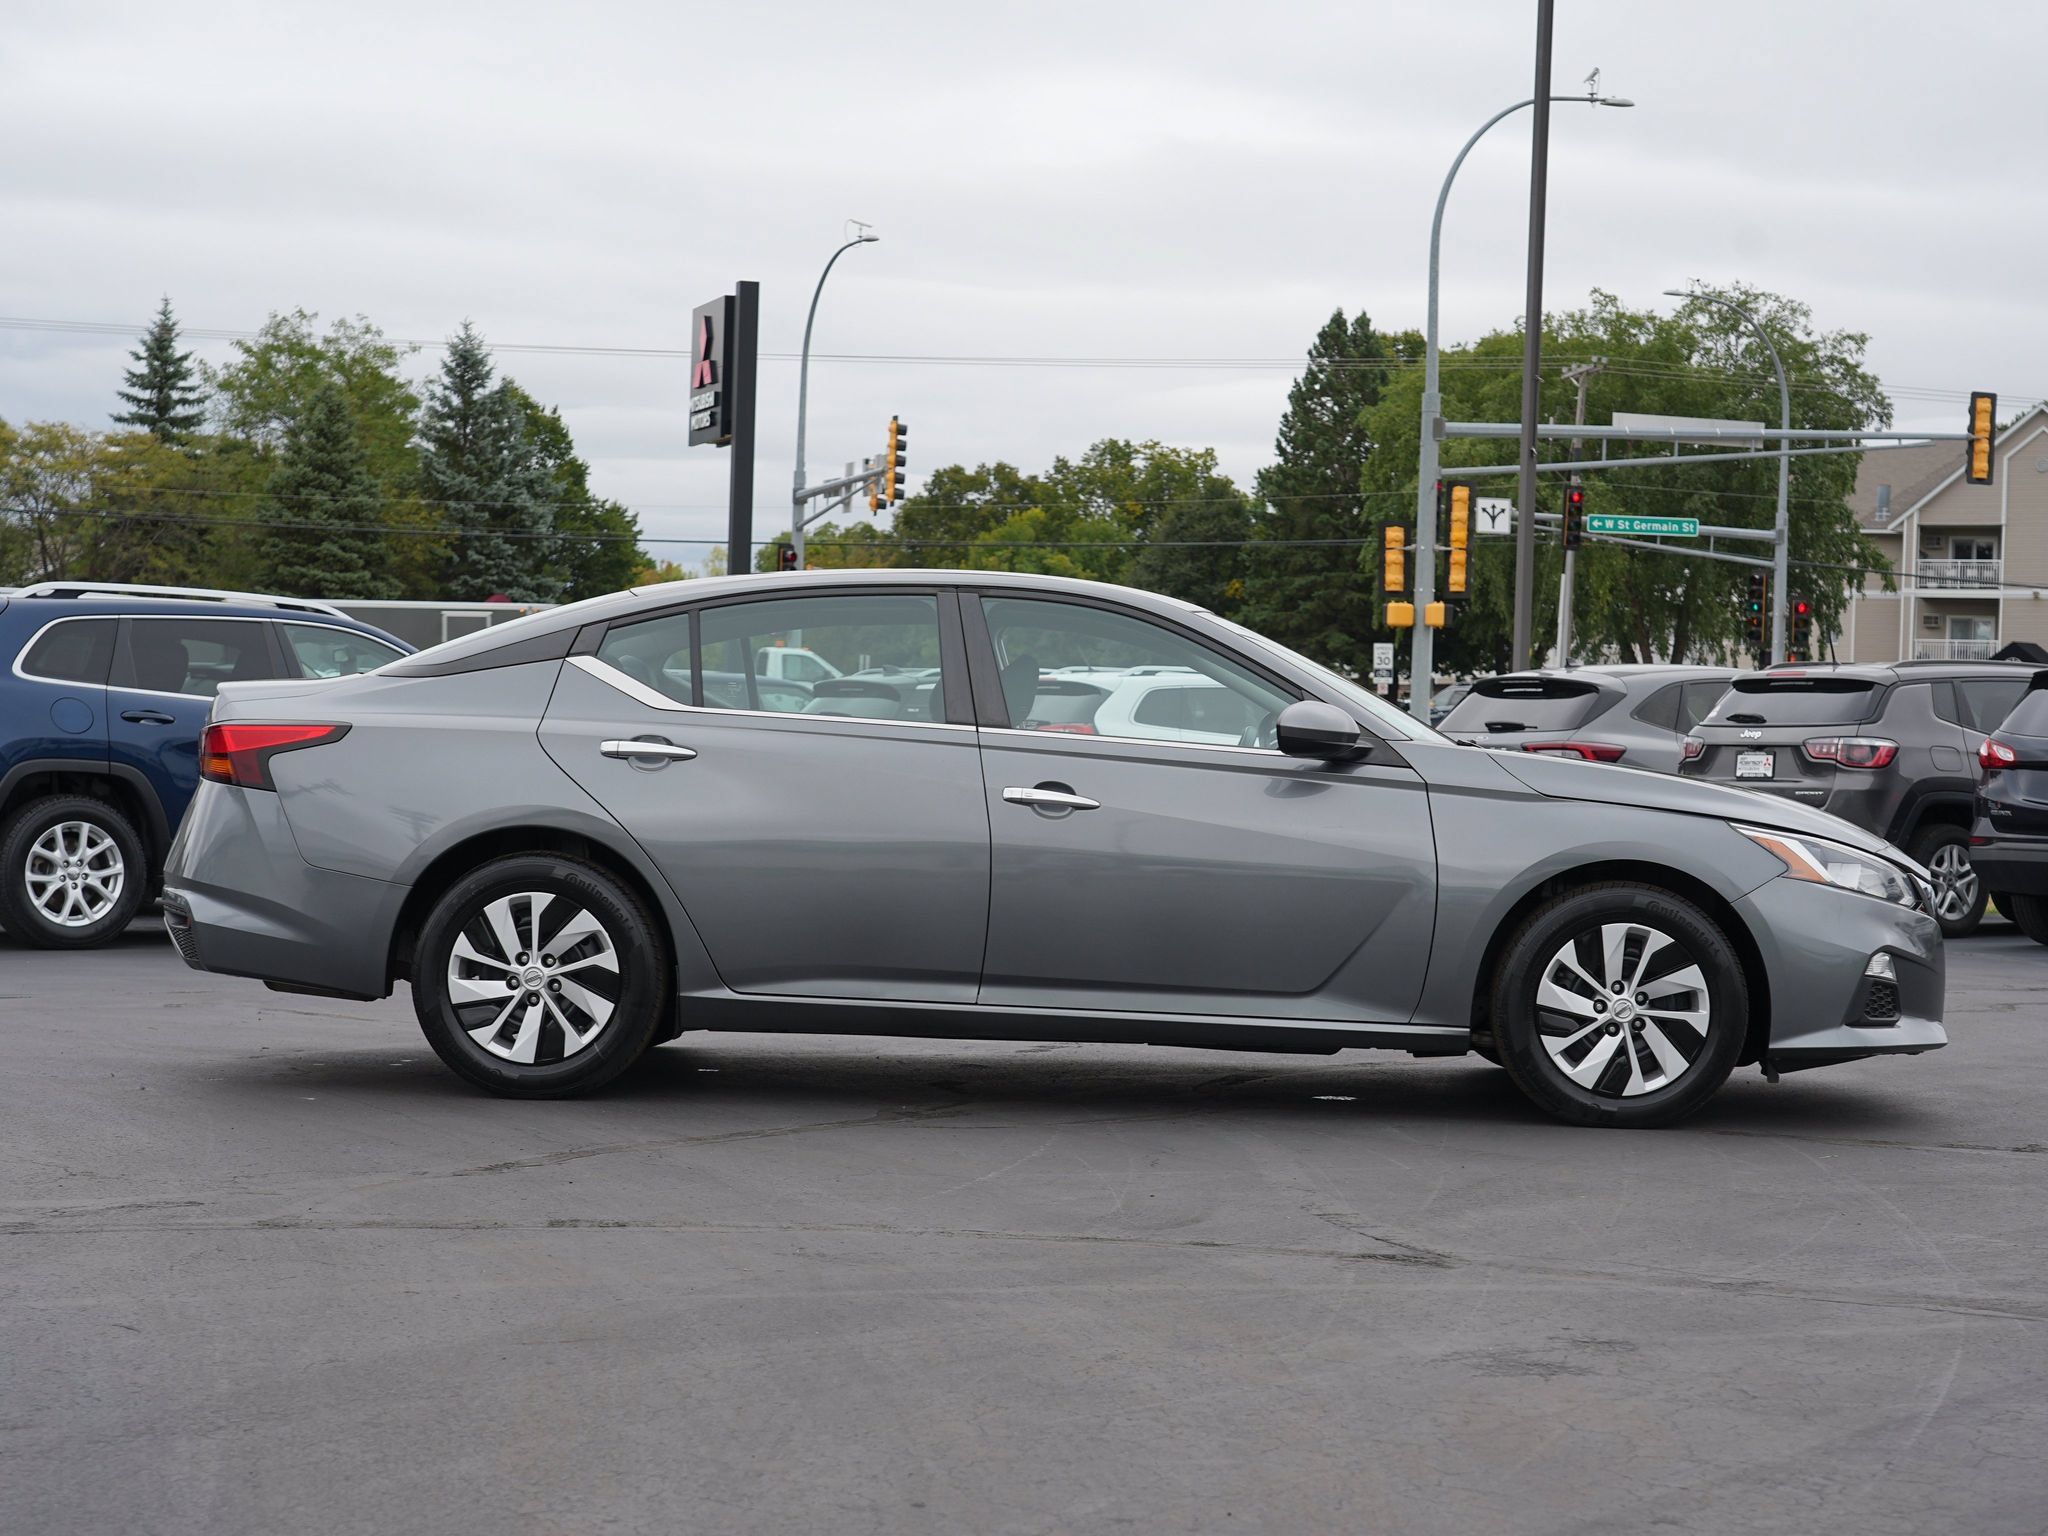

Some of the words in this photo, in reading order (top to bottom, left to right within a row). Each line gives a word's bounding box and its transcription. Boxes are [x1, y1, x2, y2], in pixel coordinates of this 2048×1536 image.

[1604, 519, 1614, 529] W
[1617, 519, 1630, 530] St
[1633, 520, 1679, 532] Germain
[1682, 522, 1695, 533] St
[1376, 656, 1391, 666] 30
[1740, 729, 1762, 740] Jeep
